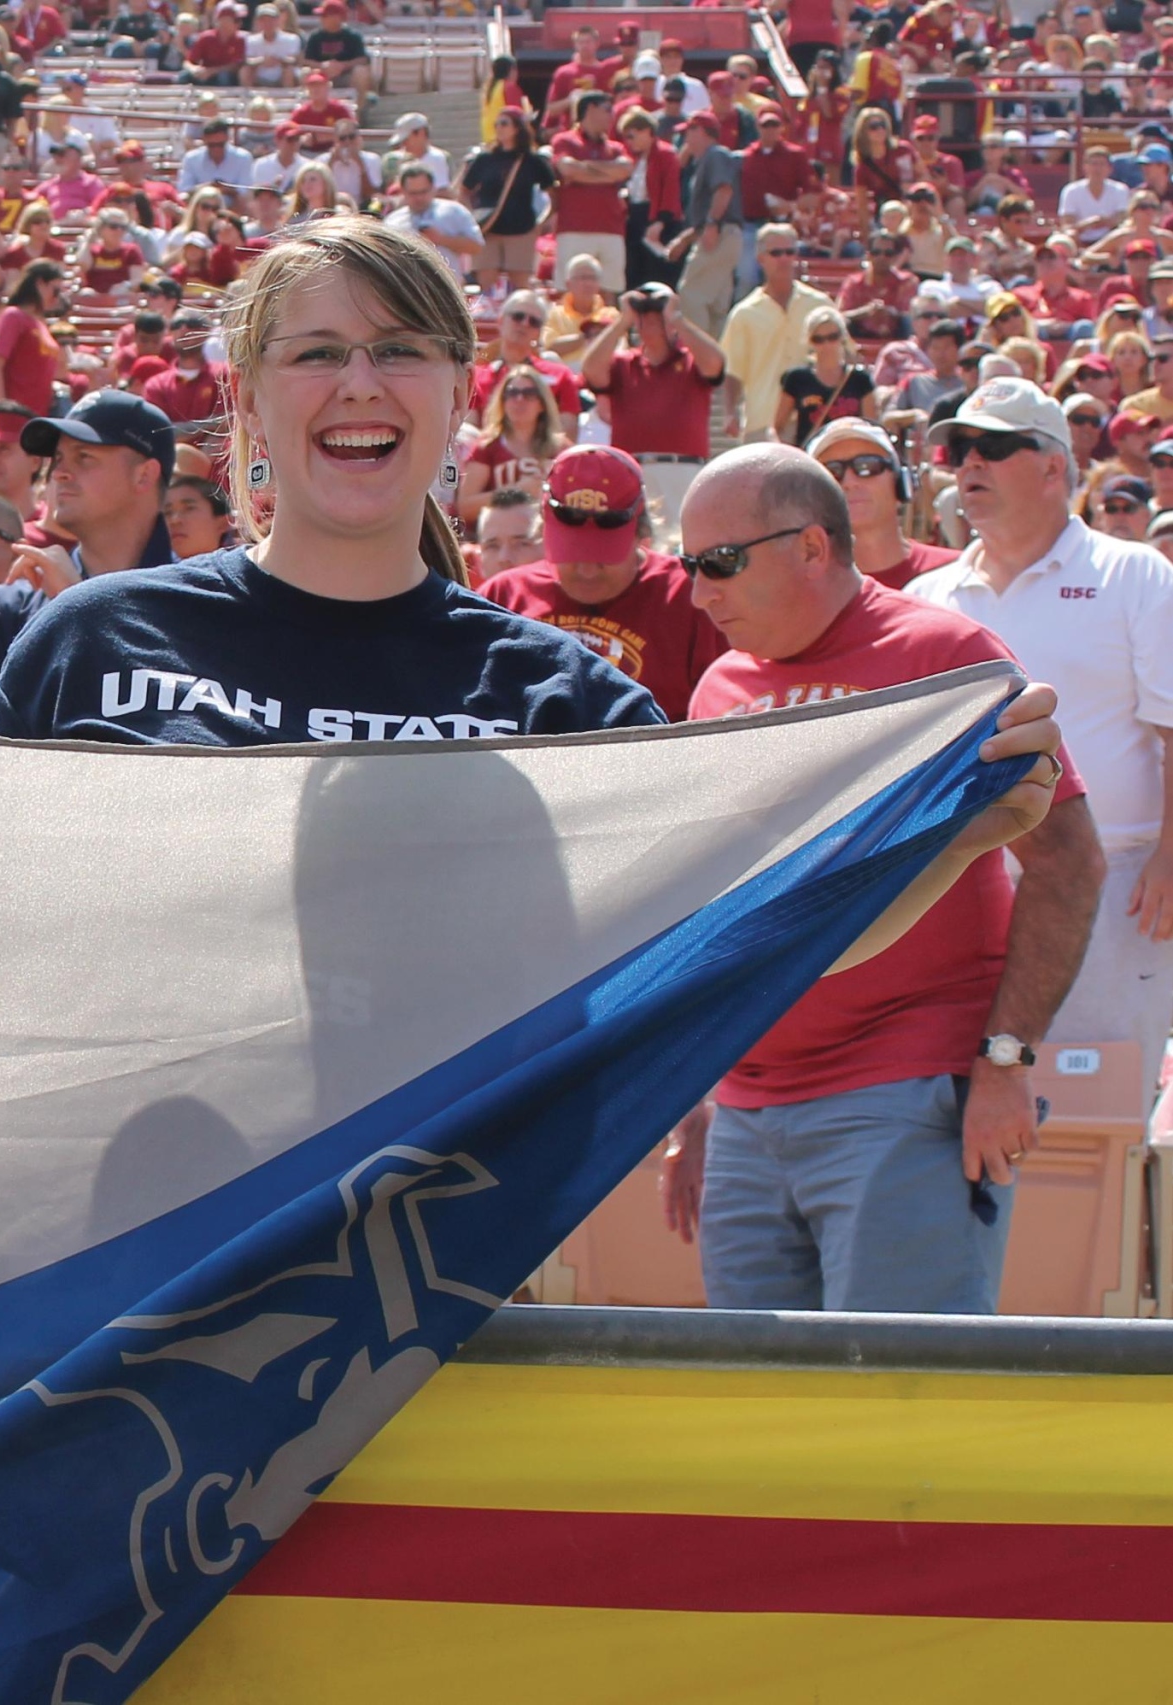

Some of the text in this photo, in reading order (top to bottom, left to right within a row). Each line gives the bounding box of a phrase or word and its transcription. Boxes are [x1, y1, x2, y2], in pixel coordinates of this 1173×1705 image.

[494, 457, 551, 490] US
[564, 488, 609, 512] USC
[1060, 586, 1097, 599] USC
[101, 669, 282, 728] UTAH
